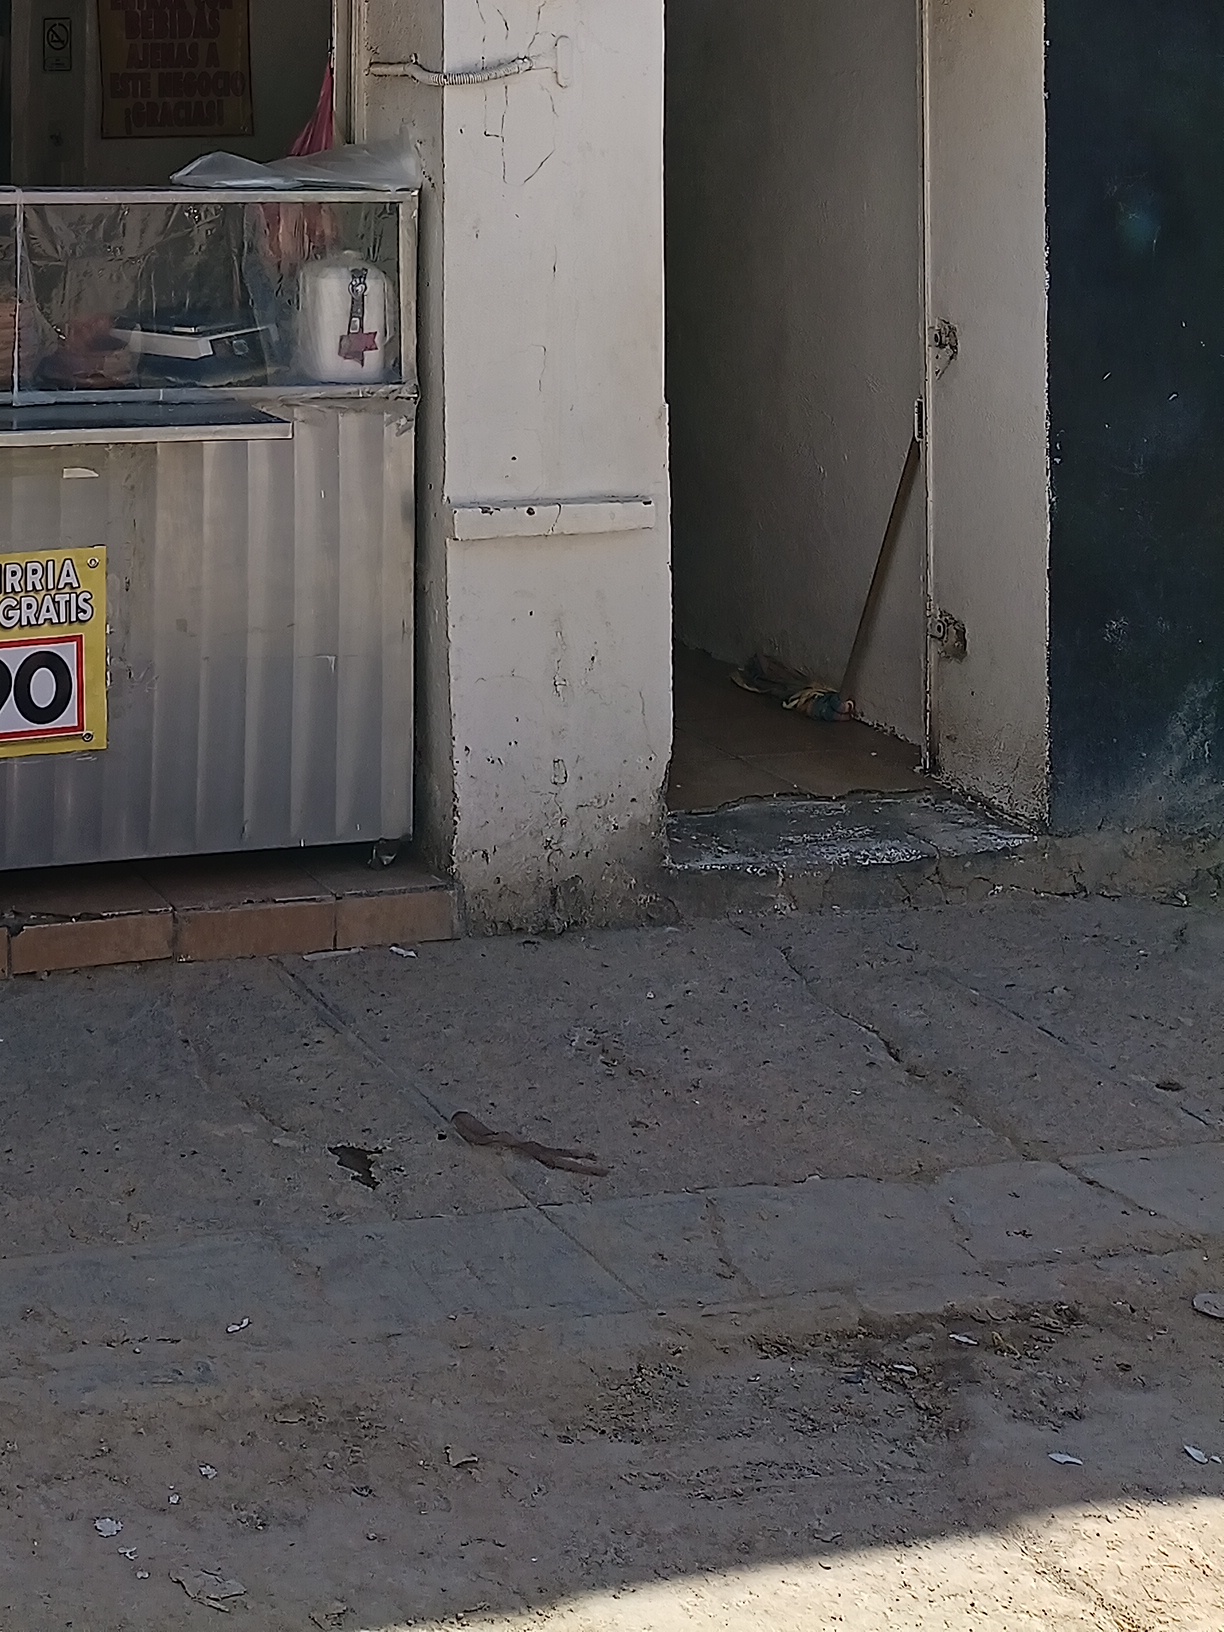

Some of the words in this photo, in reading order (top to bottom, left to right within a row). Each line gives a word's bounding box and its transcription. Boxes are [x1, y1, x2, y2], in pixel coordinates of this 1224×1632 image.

[124, 9, 221, 40] BEBIDAS
[205, 42, 220, 68] A
[110, 72, 151, 99] ESTE
[158, 70, 247, 99] NEGOCIO
